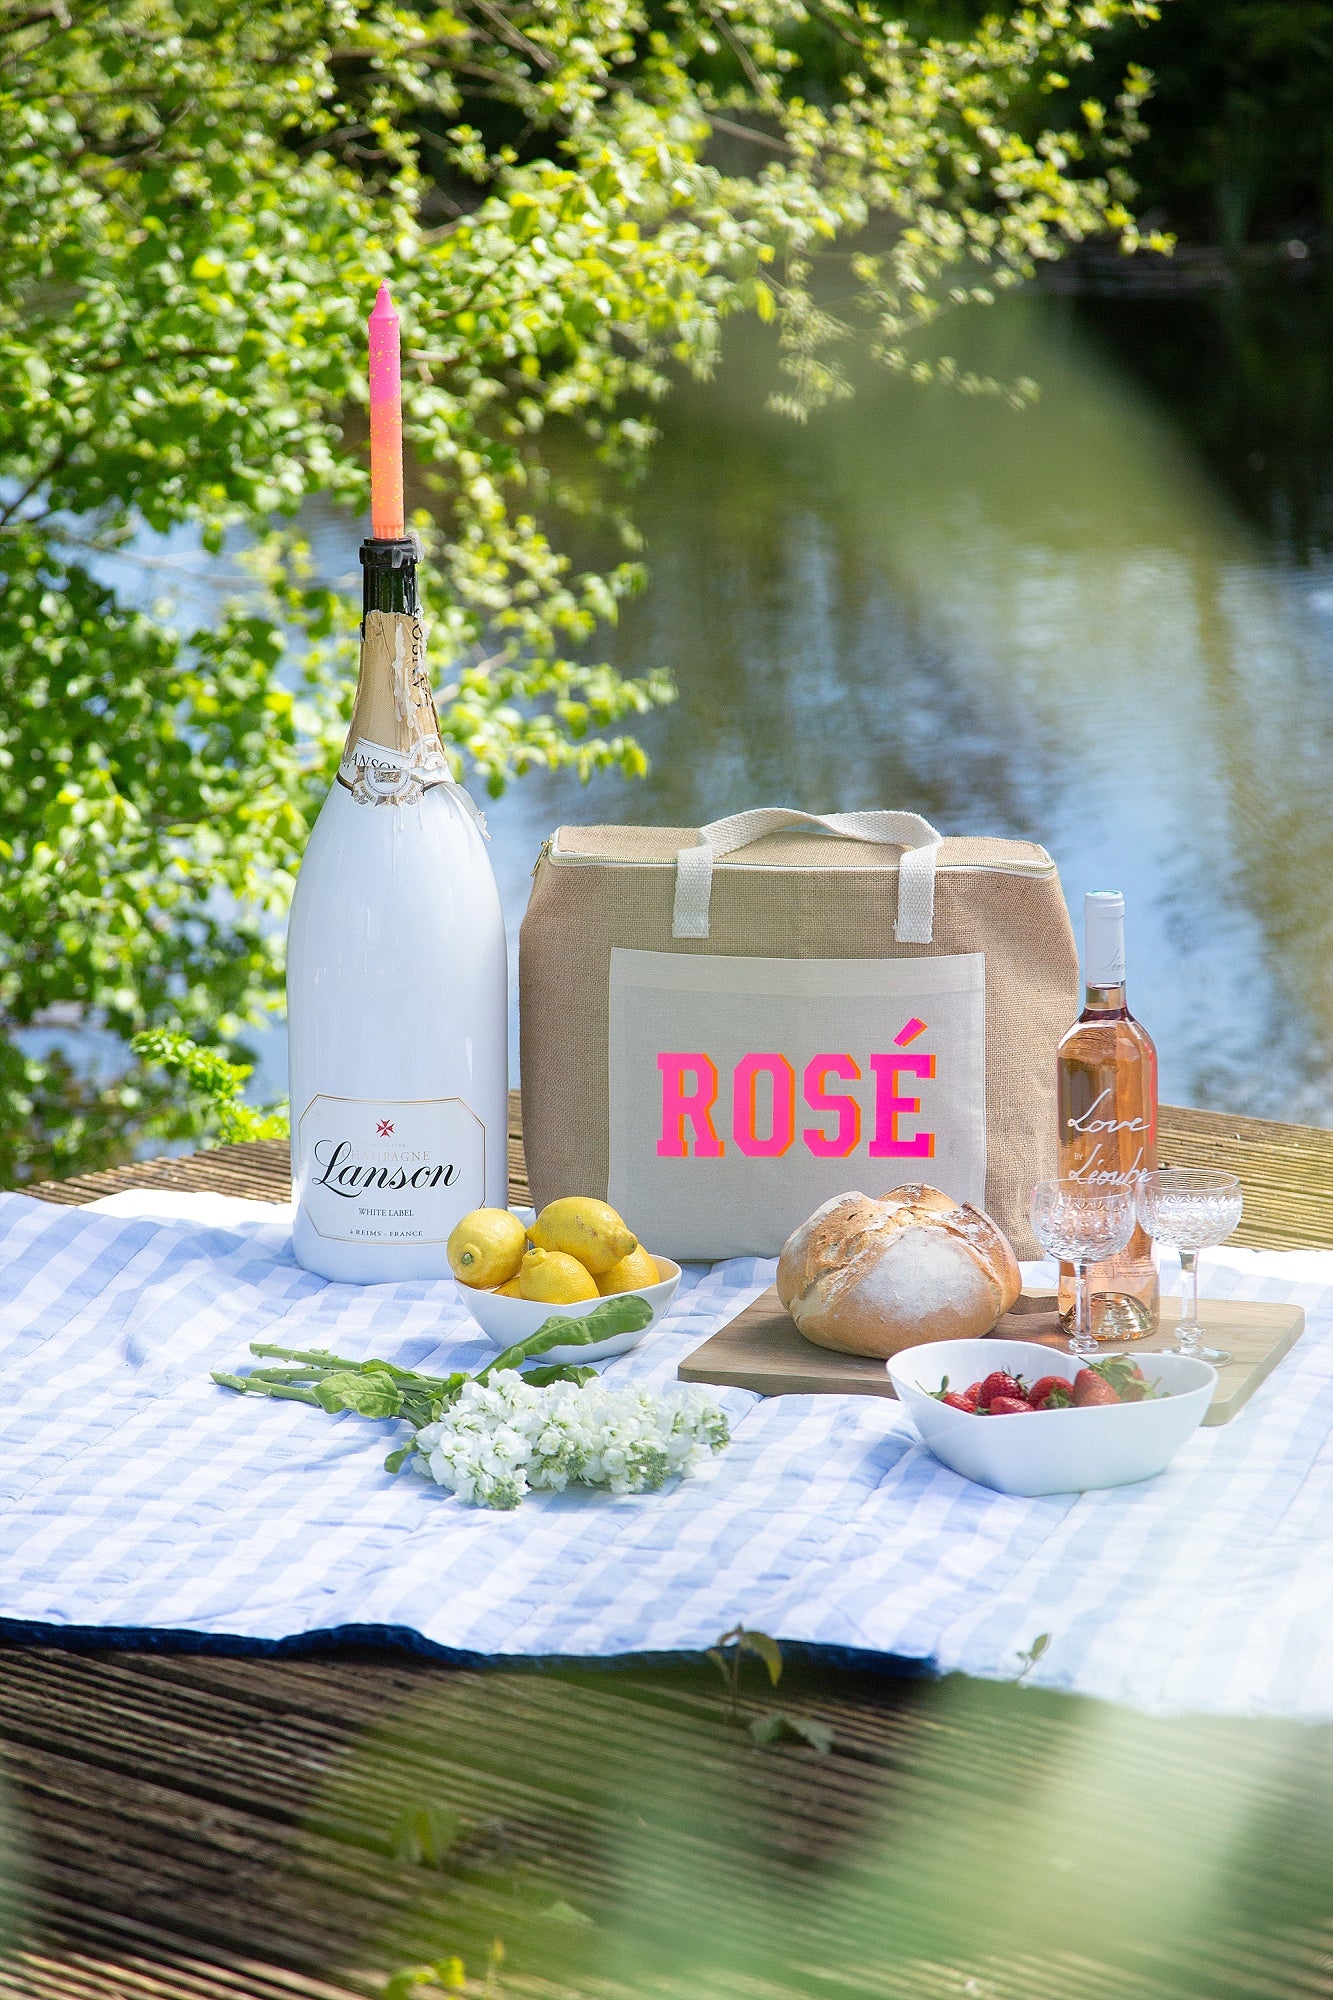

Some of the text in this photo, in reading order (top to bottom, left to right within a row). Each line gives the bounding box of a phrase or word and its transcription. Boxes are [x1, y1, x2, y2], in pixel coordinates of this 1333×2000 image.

[656, 1017, 936, 1158] ROSÉ
[1067, 1087, 1151, 1133] Love
[311, 1139, 461, 1198] Lanson
[342, 1148, 430, 1162] CHAMPAGNE
[1074, 1152, 1083, 1160] BY
[358, 1207, 415, 1217] WHITE LABEL
